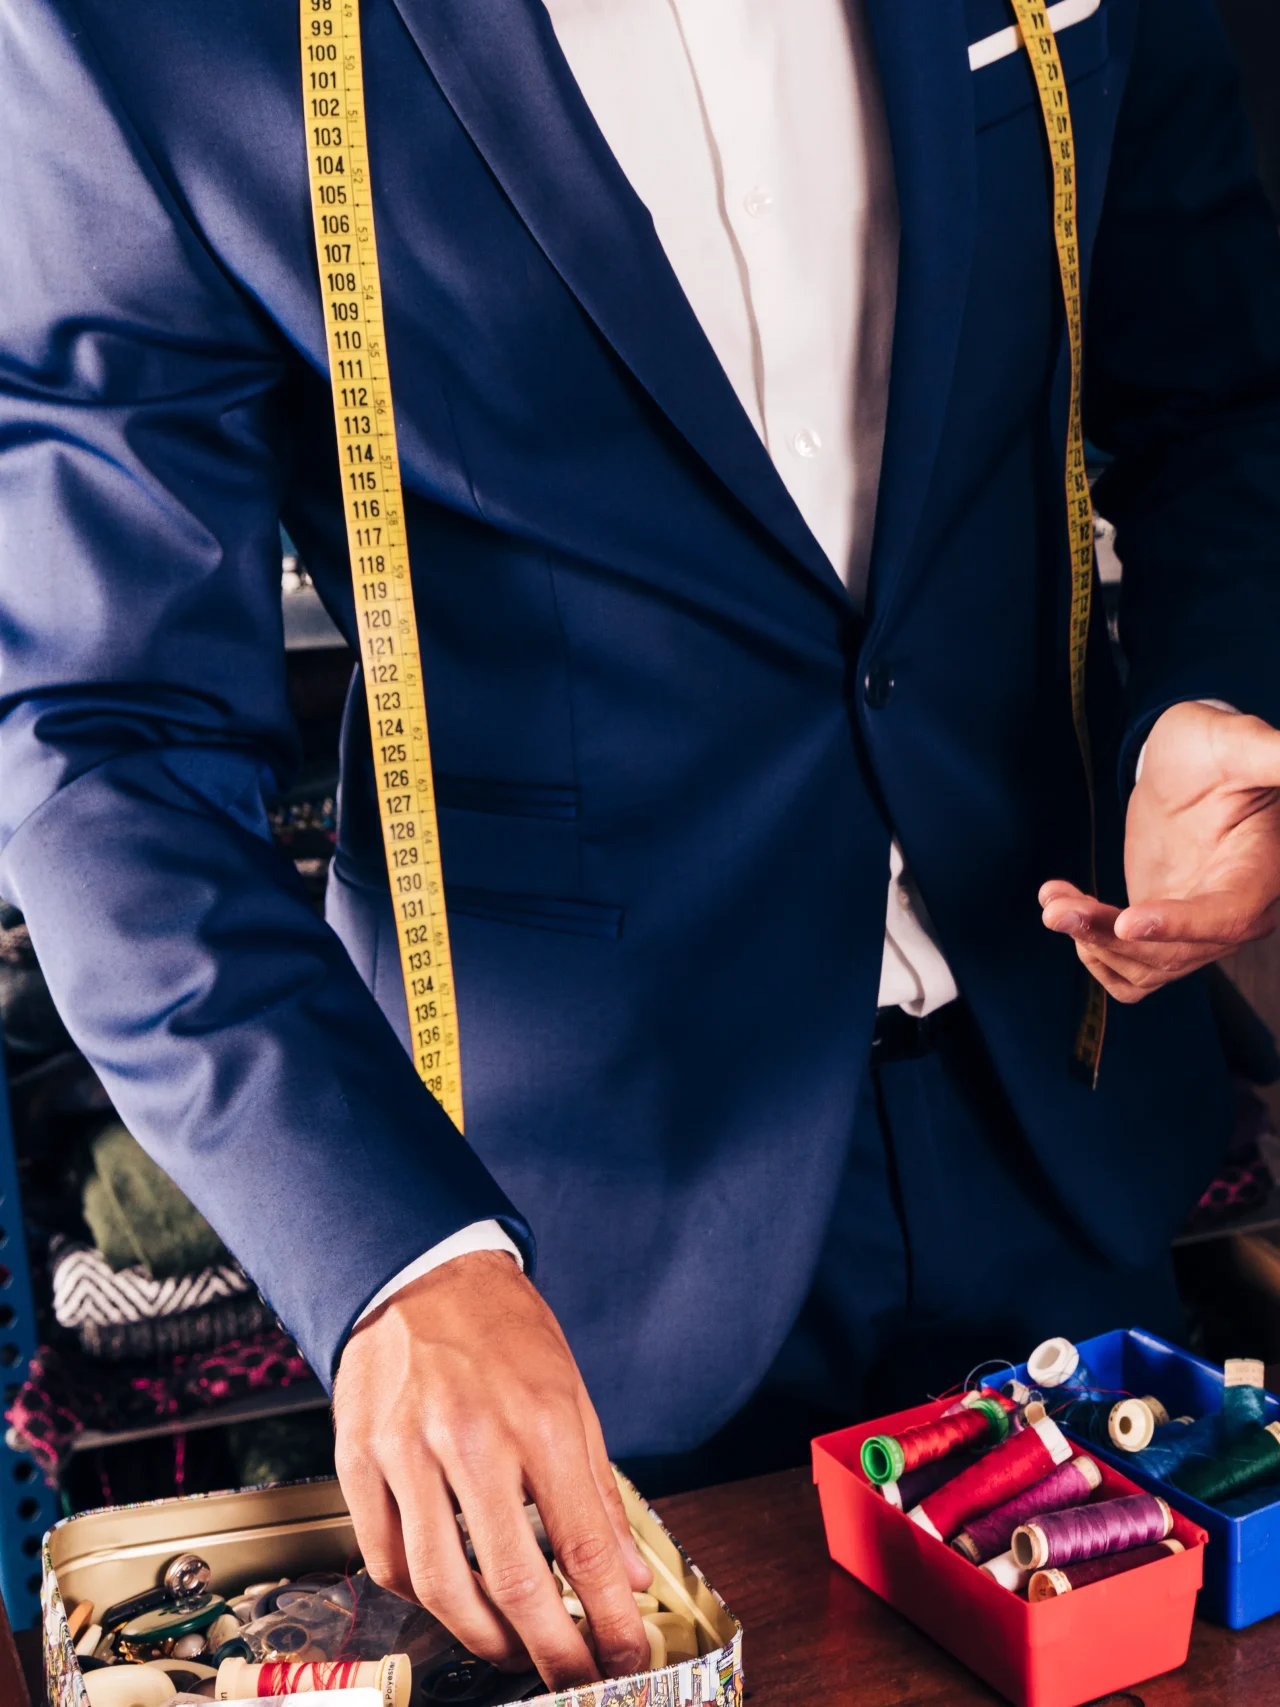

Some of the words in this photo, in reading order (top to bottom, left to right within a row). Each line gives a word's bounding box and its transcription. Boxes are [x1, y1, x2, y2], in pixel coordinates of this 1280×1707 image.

[311, 0, 331, 11] 98
[311, 20, 332, 36] 99
[307, 44, 337, 61] 100
[345, 55, 355, 71] 50
[310, 71, 336, 89] 101
[311, 98, 340, 117] 102
[347, 110, 358, 123] 51
[314, 127, 342, 146] 103
[316, 156, 344, 174] 104
[352, 168, 363, 184] 52
[318, 186, 347, 204] 105
[321, 215, 349, 234] 106
[357, 227, 368, 243] 53
[324, 244, 351, 263] 107
[327, 273, 355, 291] 108
[363, 285, 374, 301] 54
[331, 302, 358, 320] 109
[334, 331, 361, 349] 110
[369, 342, 380, 358] 55
[338, 360, 363, 378] 111
[341, 388, 368, 406] 112
[375, 399, 386, 415] 56
[344, 416, 370, 434] 113
[347, 444, 374, 463] 114
[381, 455, 393, 470] 57
[350, 472, 376, 490] 115
[353, 500, 379, 518] 116
[386, 510, 398, 525] 58
[356, 527, 381, 546] 117
[359, 555, 384, 574] 118
[362, 582, 387, 600] 119
[364, 609, 391, 628] 120
[400, 619, 411, 635] 60
[368, 636, 393, 655] 121
[371, 664, 398, 683] 122
[407, 673, 416, 687] 61
[374, 692, 400, 710] 123
[377, 718, 404, 736] 124
[413, 727, 423, 741] 62
[381, 744, 406, 763] 125
[384, 770, 409, 788] 126
[418, 778, 428, 793] 63
[386, 795, 411, 814] 127
[390, 821, 415, 840] 128
[393, 847, 418, 868] 129
[397, 873, 422, 892] 130
[401, 899, 424, 919] 131
[405, 925, 428, 946] 132
[409, 950, 431, 970] 133
[412, 976, 433, 996] 134
[415, 1001, 436, 1022] 135
[418, 1026, 440, 1048] 136
[421, 1051, 441, 1070] 137
[424, 1076, 443, 1093] 38
[385, 1661, 395, 1700] Polyester
